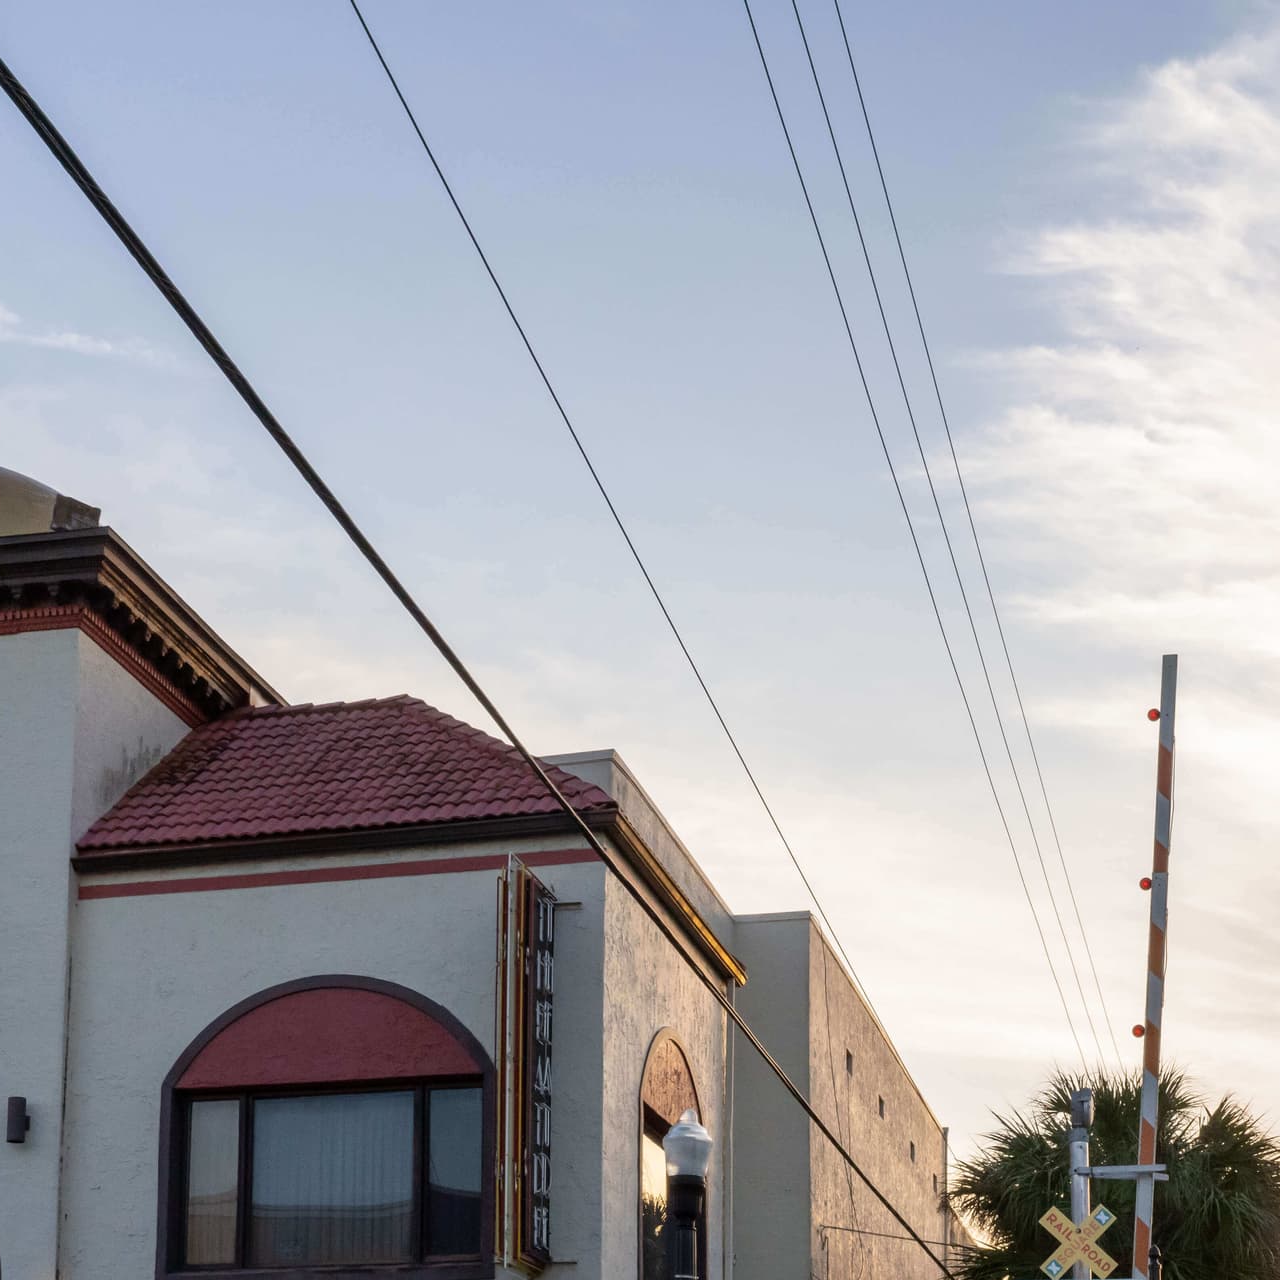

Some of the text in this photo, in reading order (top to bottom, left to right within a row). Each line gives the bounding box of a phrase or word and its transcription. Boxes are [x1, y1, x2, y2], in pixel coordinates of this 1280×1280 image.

[1046, 1213, 1111, 1272] RAIL ROAD
[1057, 1221, 1100, 1264] SQUARE
